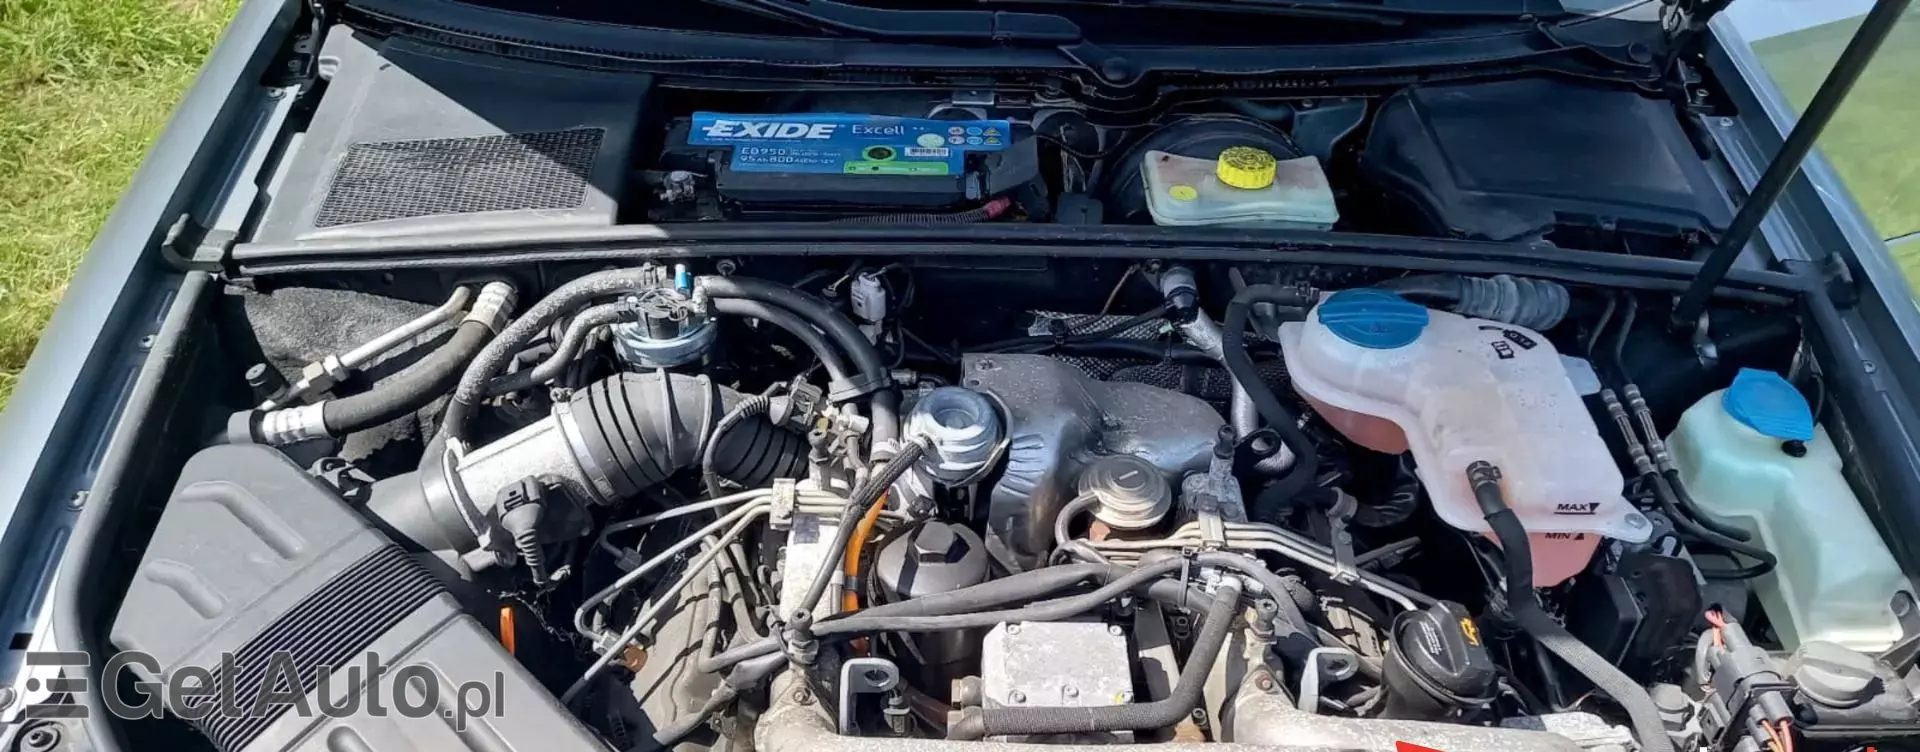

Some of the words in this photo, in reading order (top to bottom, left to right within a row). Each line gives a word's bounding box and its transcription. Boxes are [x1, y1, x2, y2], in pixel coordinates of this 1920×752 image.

[702, 119, 837, 139] EXIDE
[852, 124, 904, 135] Excell
[1557, 503, 1588, 512] MAX
[1545, 532, 1571, 540] MIN
